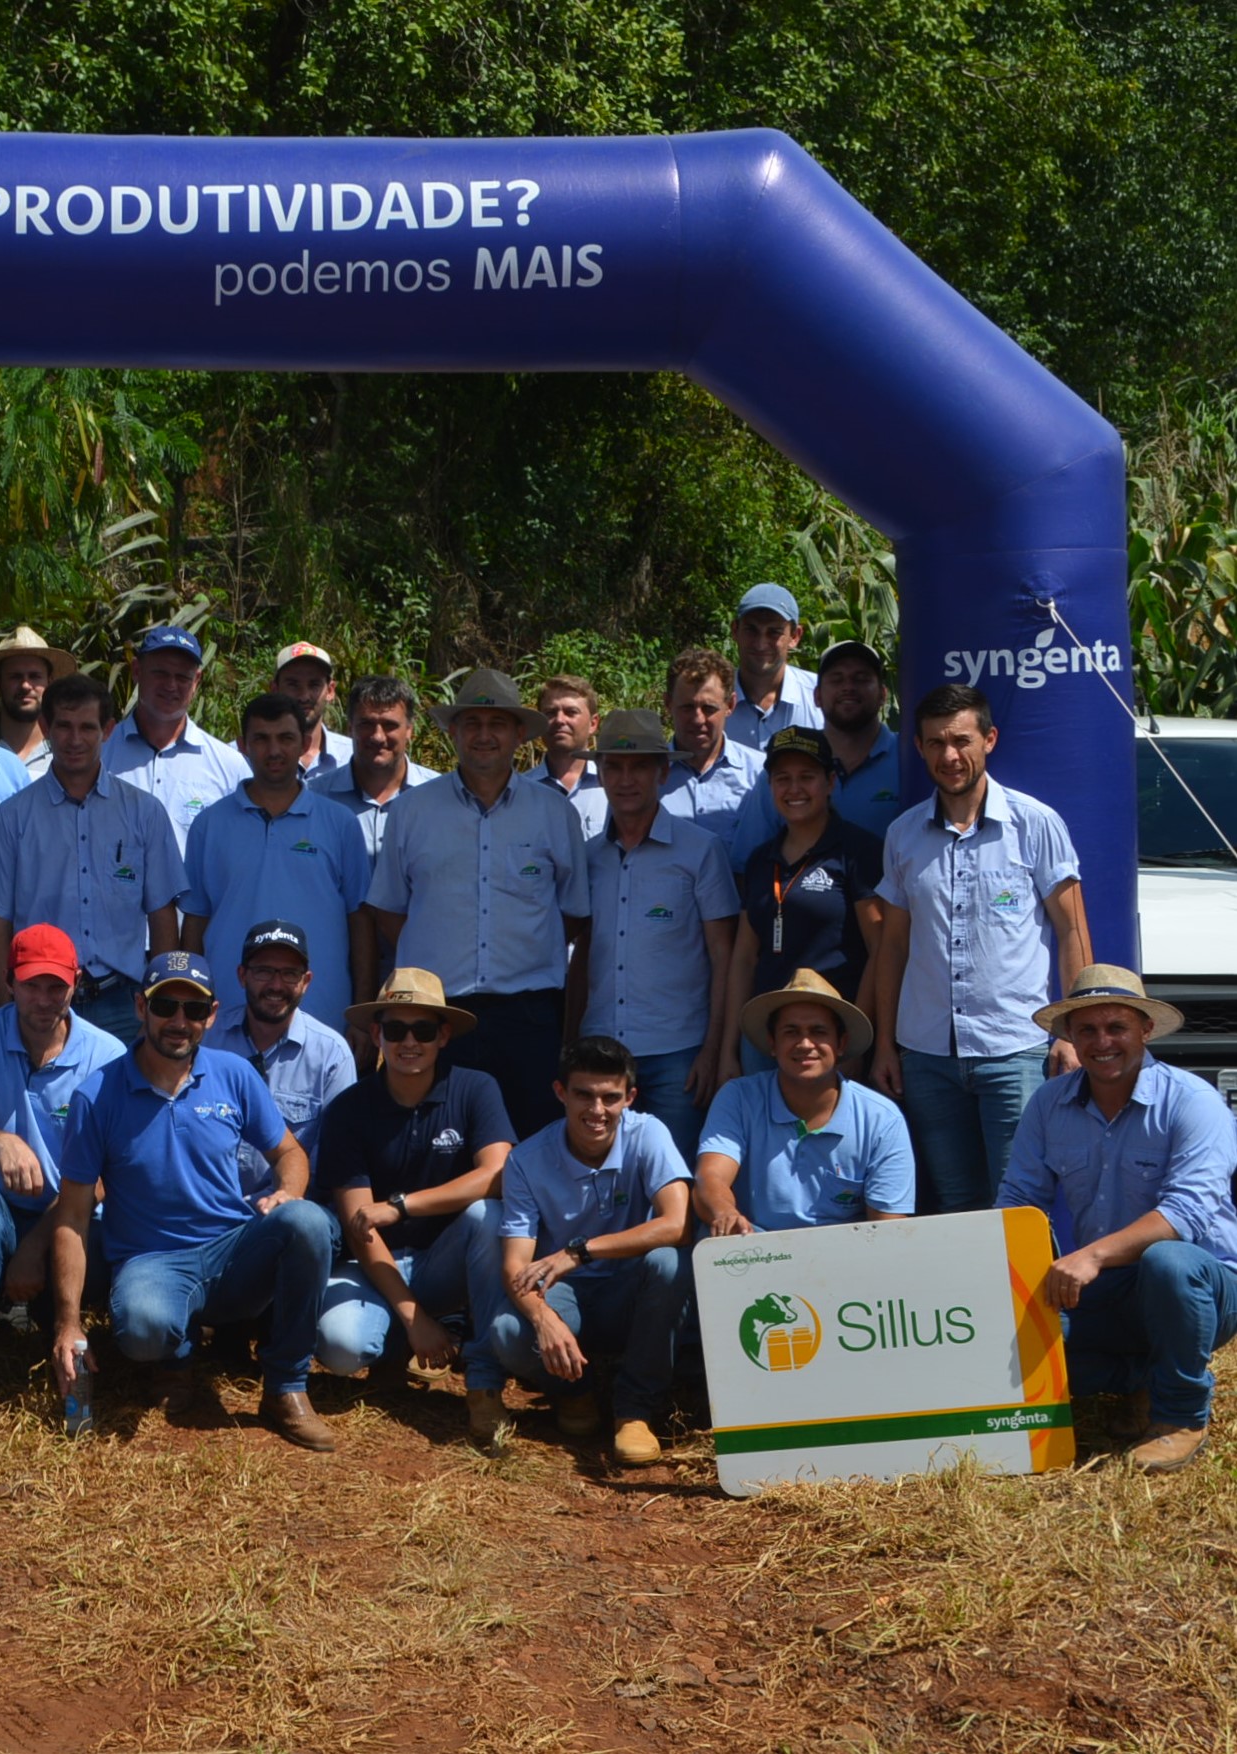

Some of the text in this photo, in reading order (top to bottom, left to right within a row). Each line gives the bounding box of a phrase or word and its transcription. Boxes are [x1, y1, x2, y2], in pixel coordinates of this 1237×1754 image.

[214, 243, 604, 305] podemos MAIS
[944, 637, 1121, 689] syngenta
[254, 930, 299, 944] syngenta
[167, 957, 188, 971] 15
[837, 1298, 976, 1352] Sillus
[986, 1411, 1049, 1431] syngenta
